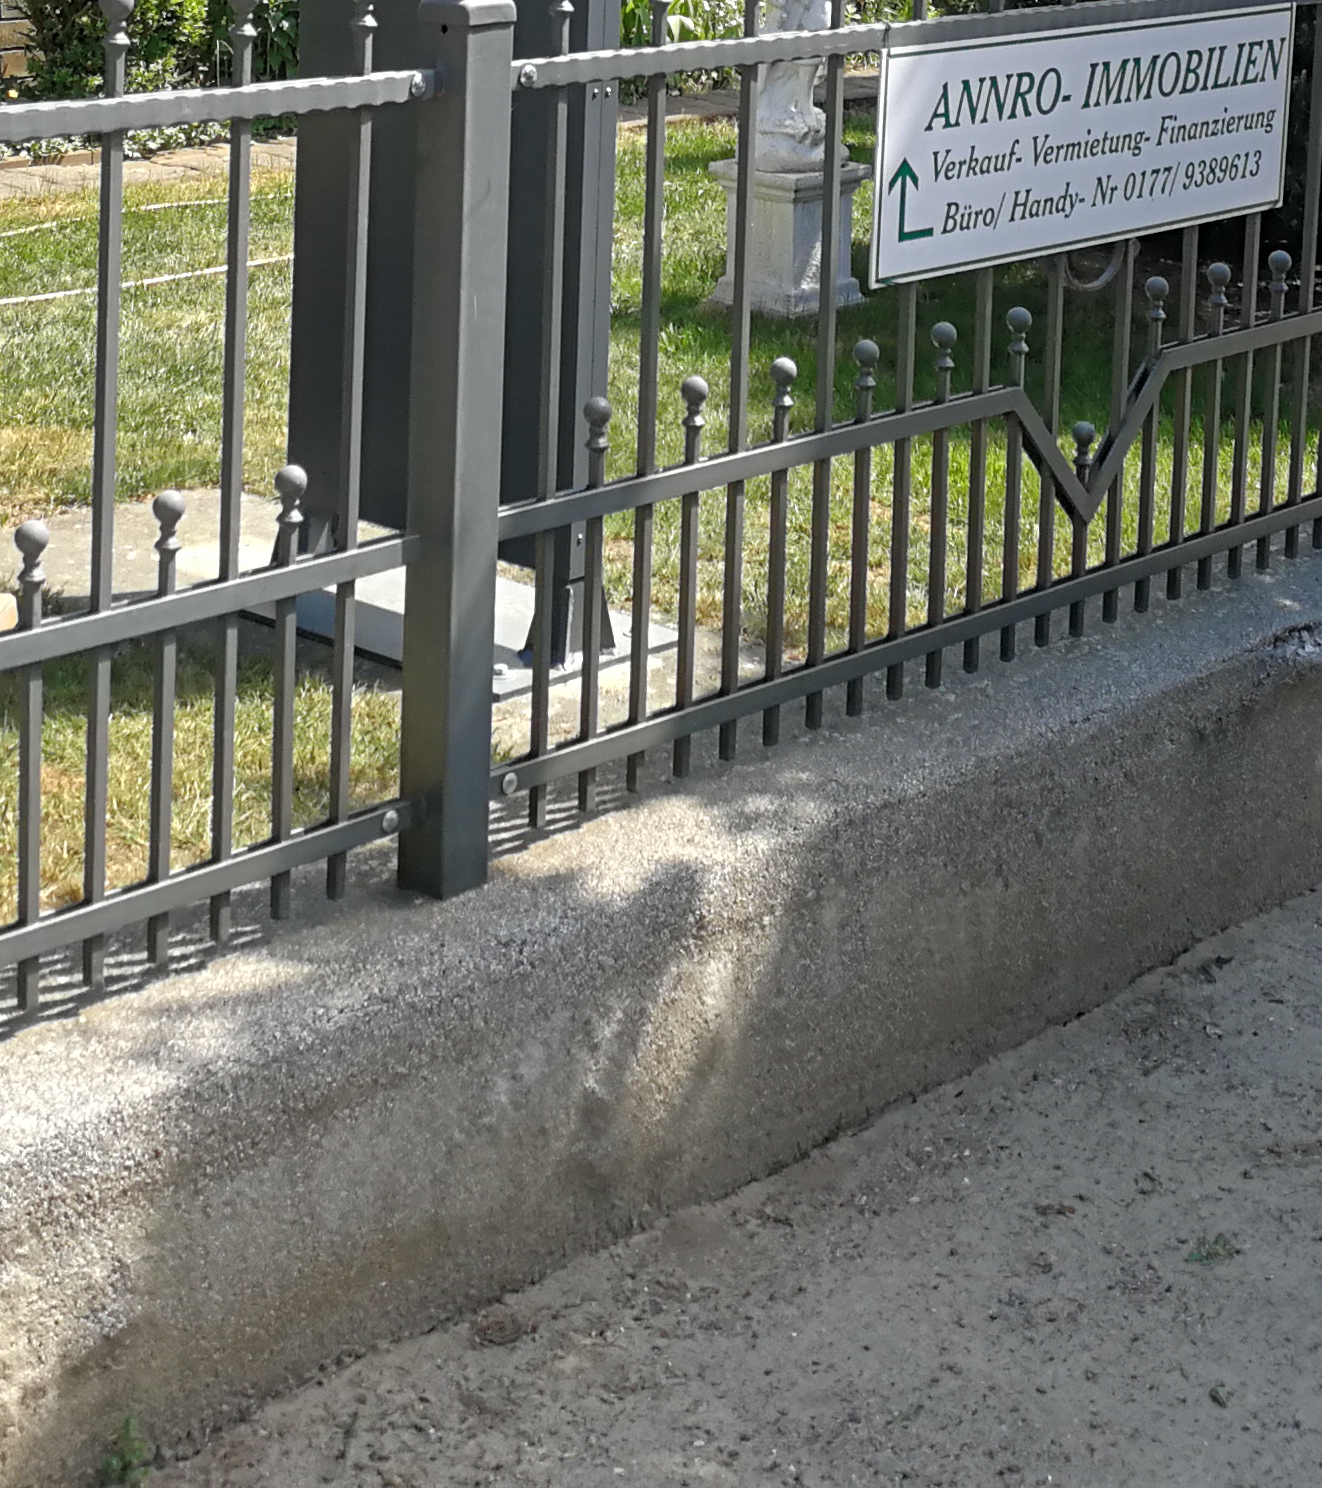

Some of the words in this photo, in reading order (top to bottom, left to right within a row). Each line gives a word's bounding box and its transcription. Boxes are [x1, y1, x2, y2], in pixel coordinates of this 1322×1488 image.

[924, 67, 1072, 132] ANNRO-
[1081, 36, 1286, 110] IMMOBILIEN
[932, 139, 1023, 183] Verkauf-
[1032, 128, 1151, 166] Vermietung-
[1155, 107, 1277, 147] Finanzierung
[941, 193, 1006, 235] Büro/
[1008, 181, 1085, 223] Handy-
[1091, 176, 1118, 208] Nr
[1123, 163, 1178, 201] 0177/
[1182, 150, 1262, 190] 9389613
